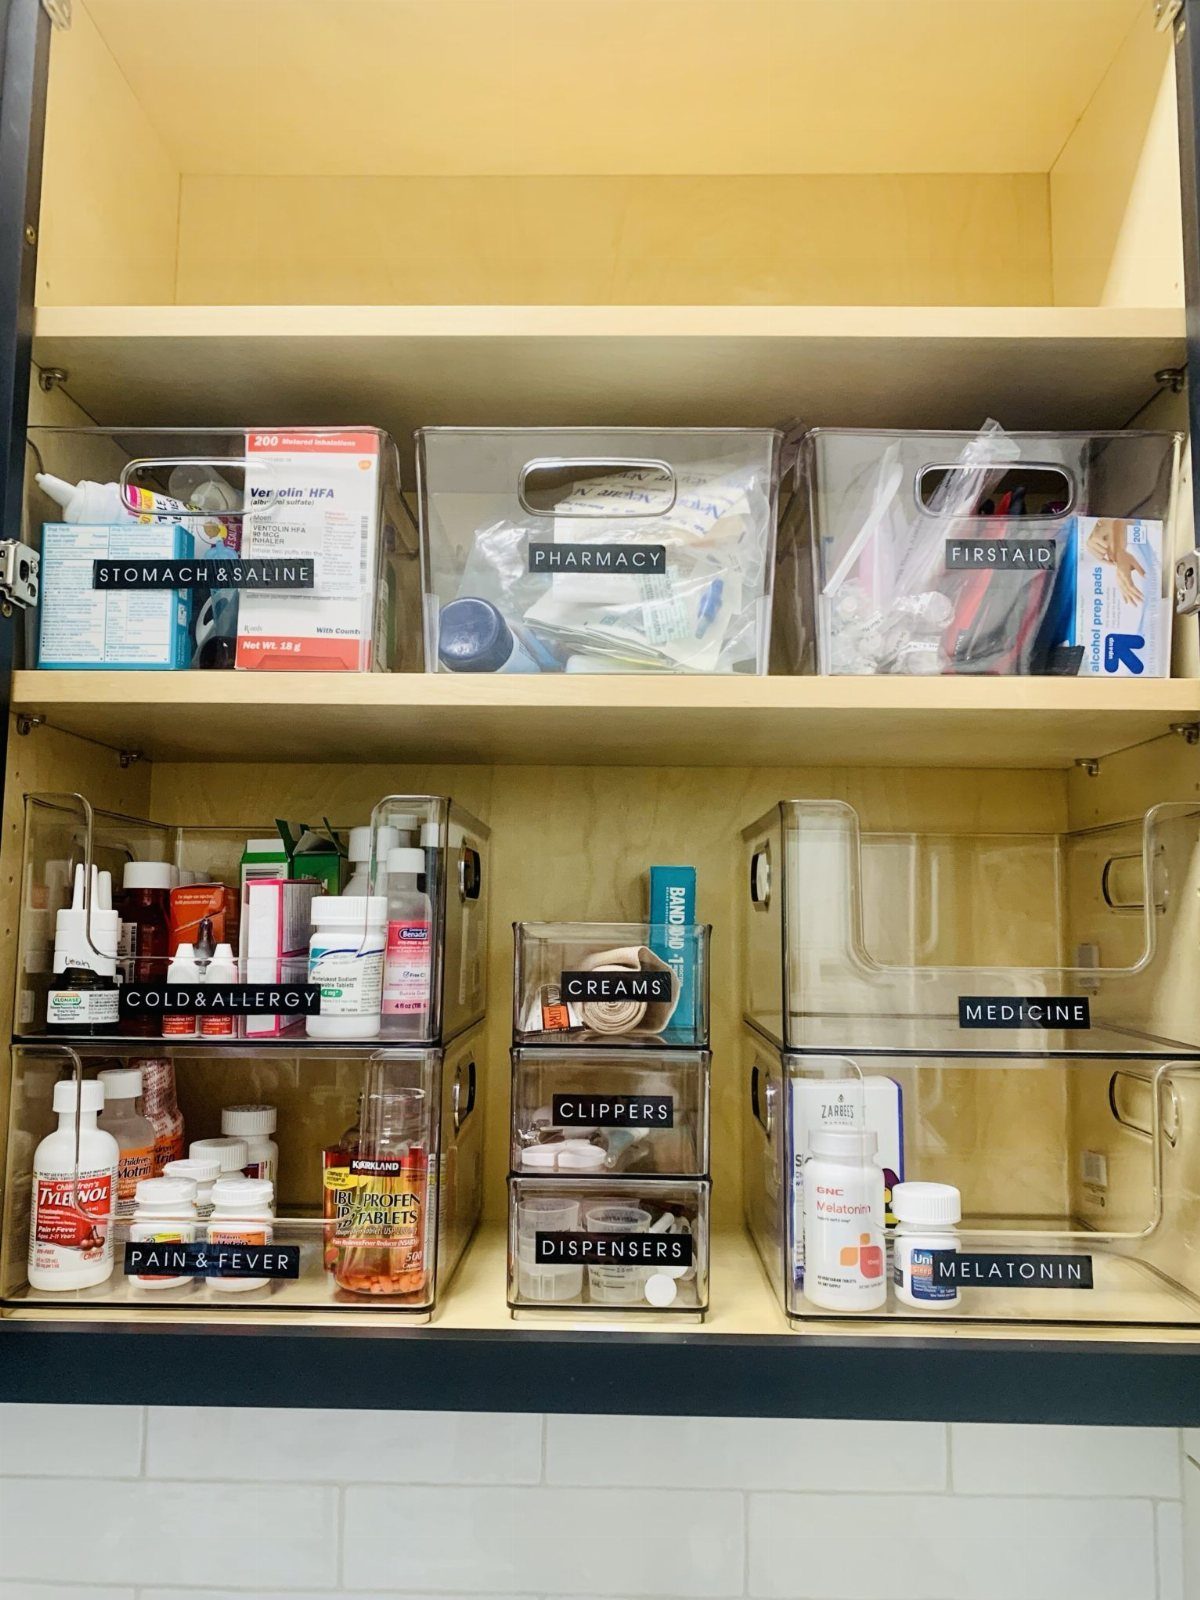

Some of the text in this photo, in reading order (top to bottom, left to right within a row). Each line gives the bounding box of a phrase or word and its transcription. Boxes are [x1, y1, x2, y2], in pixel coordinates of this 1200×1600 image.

[254, 436, 279, 446] 200
[309, 488, 335, 498] HFA
[535, 552, 661, 567] PHARMACY
[100, 568, 208, 582] STOMACH
[1091, 566, 1103, 672] alcohol prep pads
[243, 642, 260, 650] Net
[280, 642, 292, 650] 18
[294, 643, 302, 652] g
[568, 980, 662, 994] CREAMS
[966, 1005, 1084, 1020] MEDICINE
[560, 1102, 668, 1120] CLIPPERS
[816, 1187, 844, 1196] GNC
[542, 1240, 682, 1258] DISPENSERS
[131, 1252, 289, 1270] PAIN & FEVER
[914, 1255, 933, 1264] Uni
[940, 1262, 1081, 1280] MELATONIN
